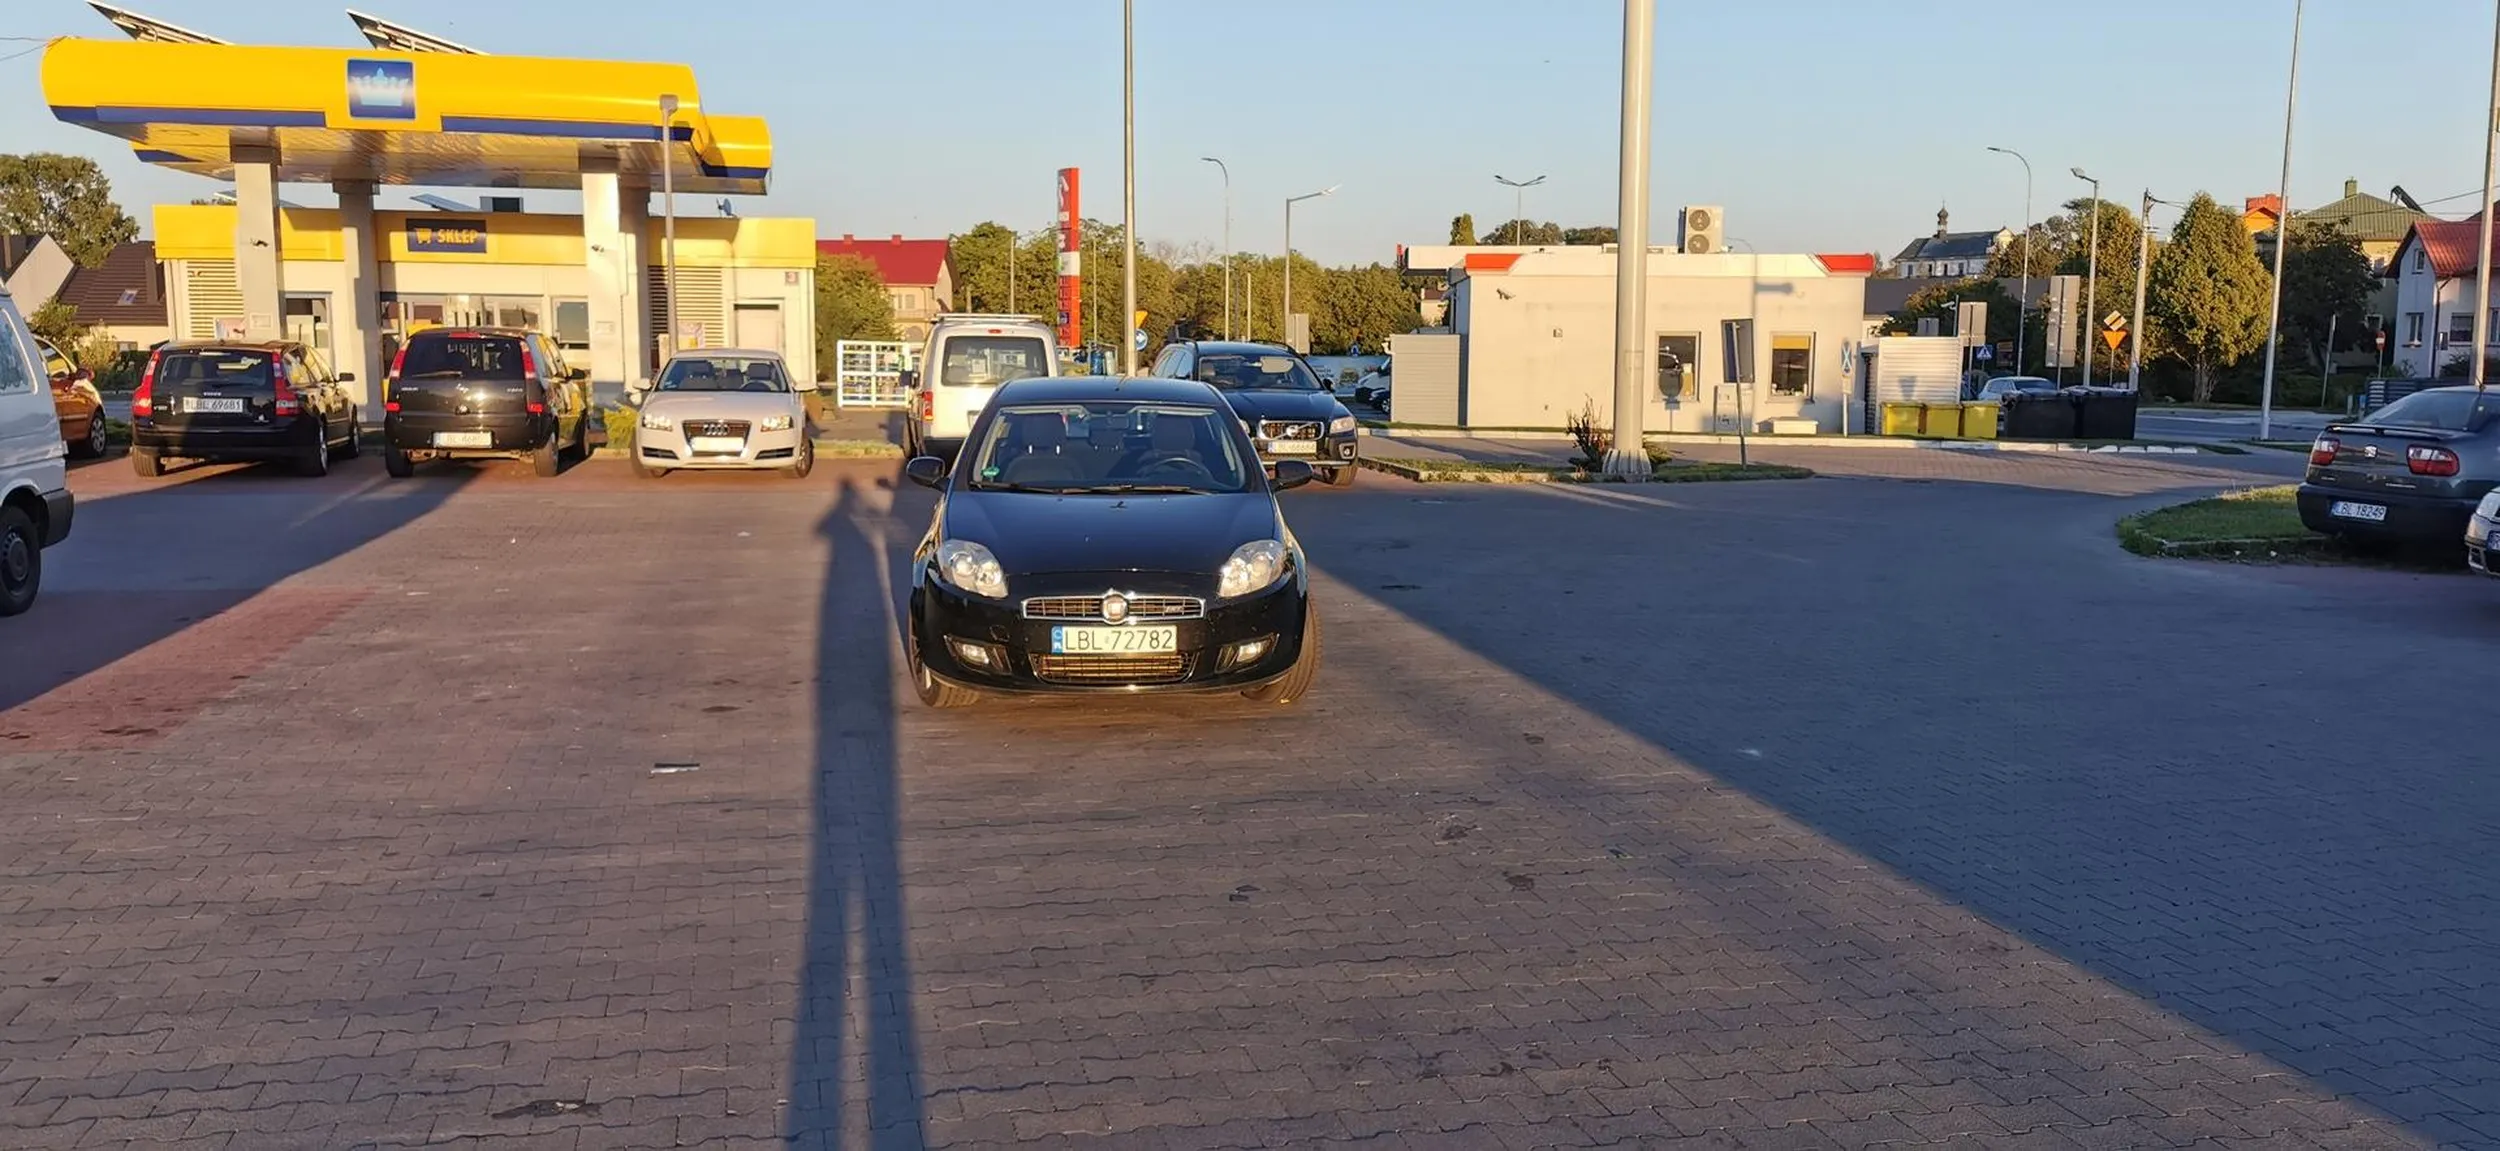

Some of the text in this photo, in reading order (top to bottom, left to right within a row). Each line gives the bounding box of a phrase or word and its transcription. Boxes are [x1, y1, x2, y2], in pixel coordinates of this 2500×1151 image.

[437, 229, 478, 244] SKLEP
[1065, 630, 1174, 650] LBL 72782
